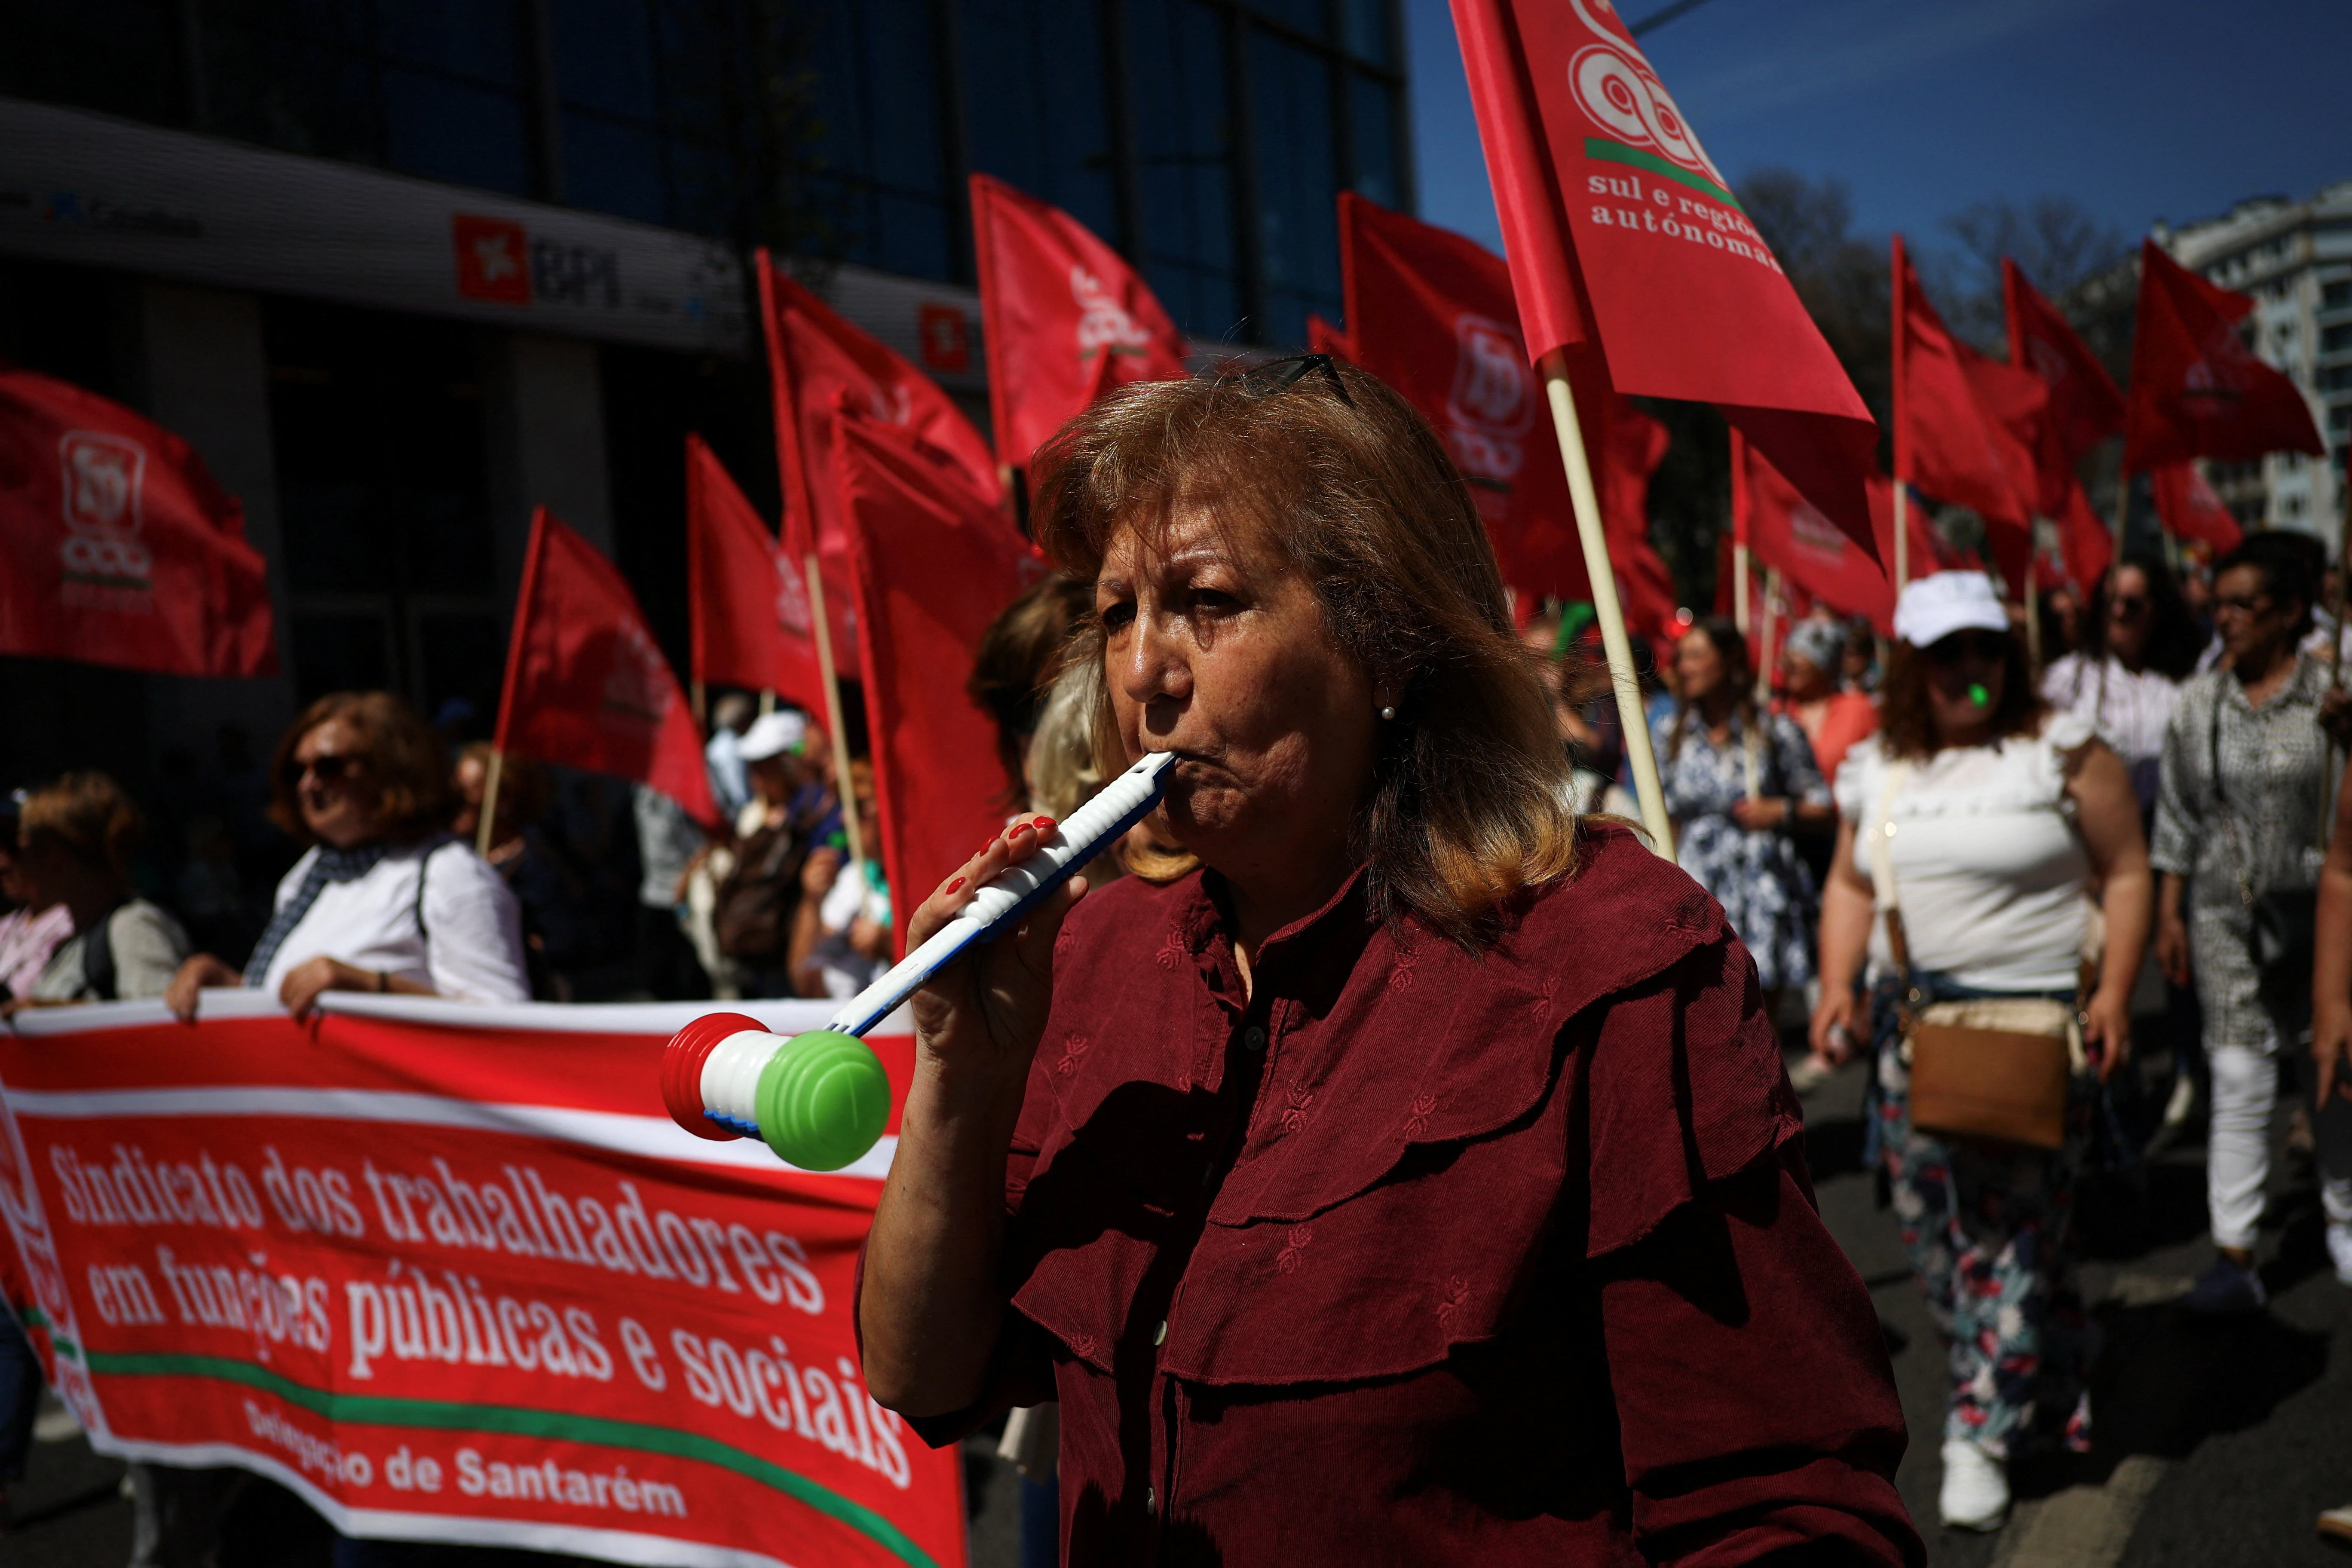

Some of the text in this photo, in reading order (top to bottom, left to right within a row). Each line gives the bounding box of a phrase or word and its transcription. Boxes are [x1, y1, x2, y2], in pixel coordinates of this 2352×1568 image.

[1587, 175, 1767, 248] sul e regiõ
[534, 239, 622, 307] BPI
[48, 1142, 826, 1316] Sindicato dos trabalhadores
[86, 1242, 912, 1491] em funções públicas e sociais
[384, 1444, 445, 1493] de
[454, 1447, 689, 1518] Santarém
